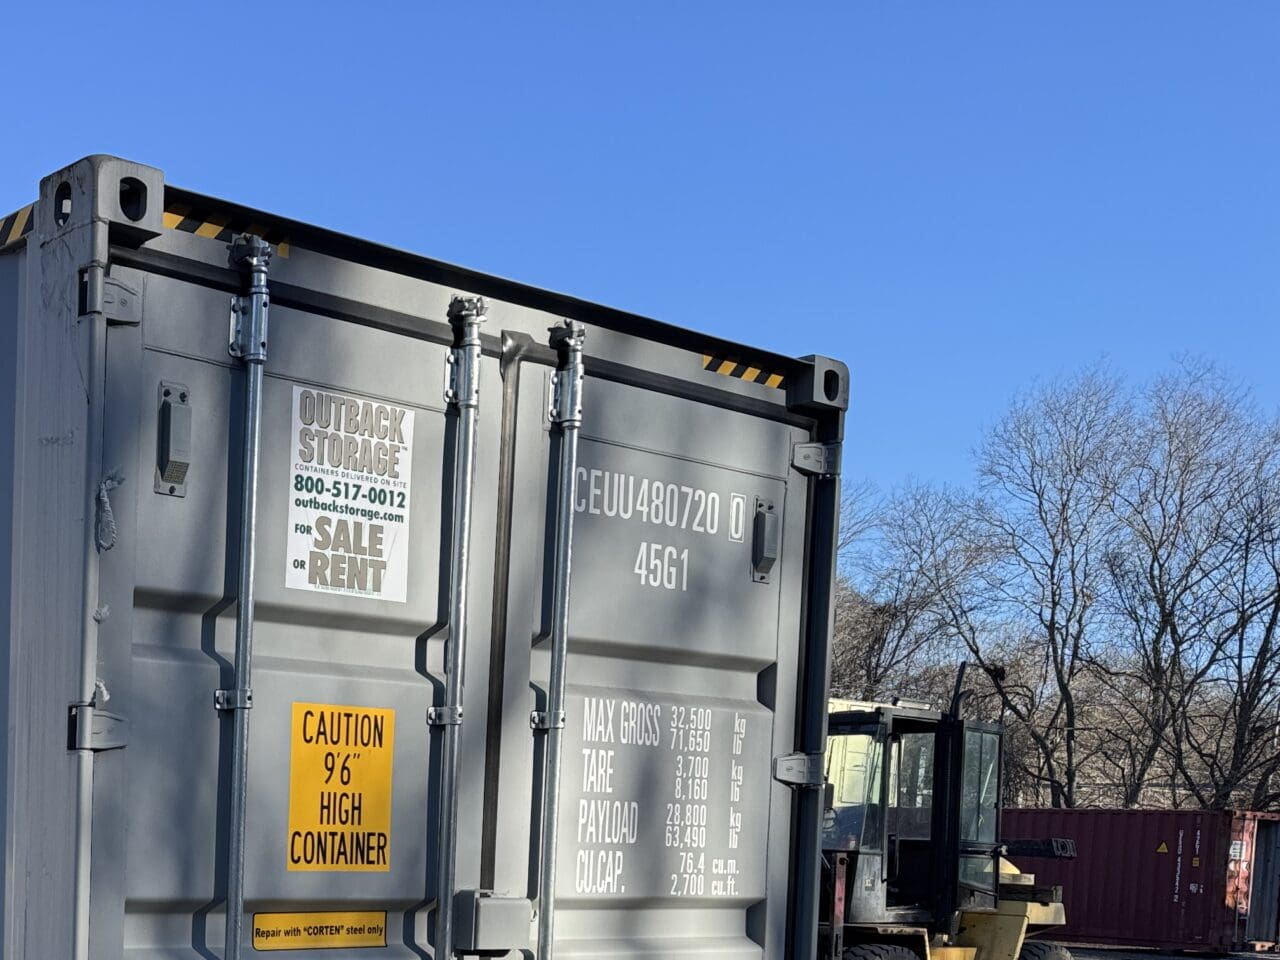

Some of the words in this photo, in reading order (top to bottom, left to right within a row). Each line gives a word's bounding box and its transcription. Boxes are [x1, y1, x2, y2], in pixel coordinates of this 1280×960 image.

[299, 389, 406, 444] OUTBACK
[298, 427, 401, 479] STORAGE
[294, 474, 406, 508] 800-517-0012
[295, 463, 339, 477] CONTAINERS
[341, 471, 378, 484] DELIVERED
[380, 479, 390, 487] ON
[392, 480, 407, 489] SITE
[294, 497, 404, 523] outbackstorage.com
[295, 523, 312, 535] FOR
[314, 515, 384, 558] SALE
[292, 559, 306, 570] OR
[308, 550, 386, 593] RENT
[634, 541, 689, 591] 45G1
[302, 710, 384, 748] CAUTION
[583, 697, 615, 743] MAX
[620, 700, 661, 746] GROSS
[670, 706, 712, 731] 32,500
[734, 712, 747, 738] kg
[670, 729, 711, 753] 71,650
[732, 734, 742, 755] lb
[582, 748, 615, 793] TARE
[676, 755, 709, 778] 3,700
[731, 760, 744, 785] kg
[675, 778, 708, 800] 8,160
[730, 780, 740, 802] lb
[319, 791, 362, 826] HIGH
[577, 799, 639, 844] PAYLOAD
[666, 803, 707, 826] 28,800
[729, 806, 742, 832] kg
[290, 831, 387, 866] CONTAINER
[665, 826, 706, 848] 63,490
[728, 828, 738, 849] lb
[575, 849, 625, 894] CU.CAP.
[680, 852, 705, 874] 76.4
[712, 858, 740, 874] cu.m.
[670, 874, 704, 896] 2,700
[711, 876, 739, 896] cu.ft.
[255, 926, 281, 940] Repair
[284, 926, 301, 937] with
[346, 924, 365, 935] steel
[367, 924, 384, 936] only
